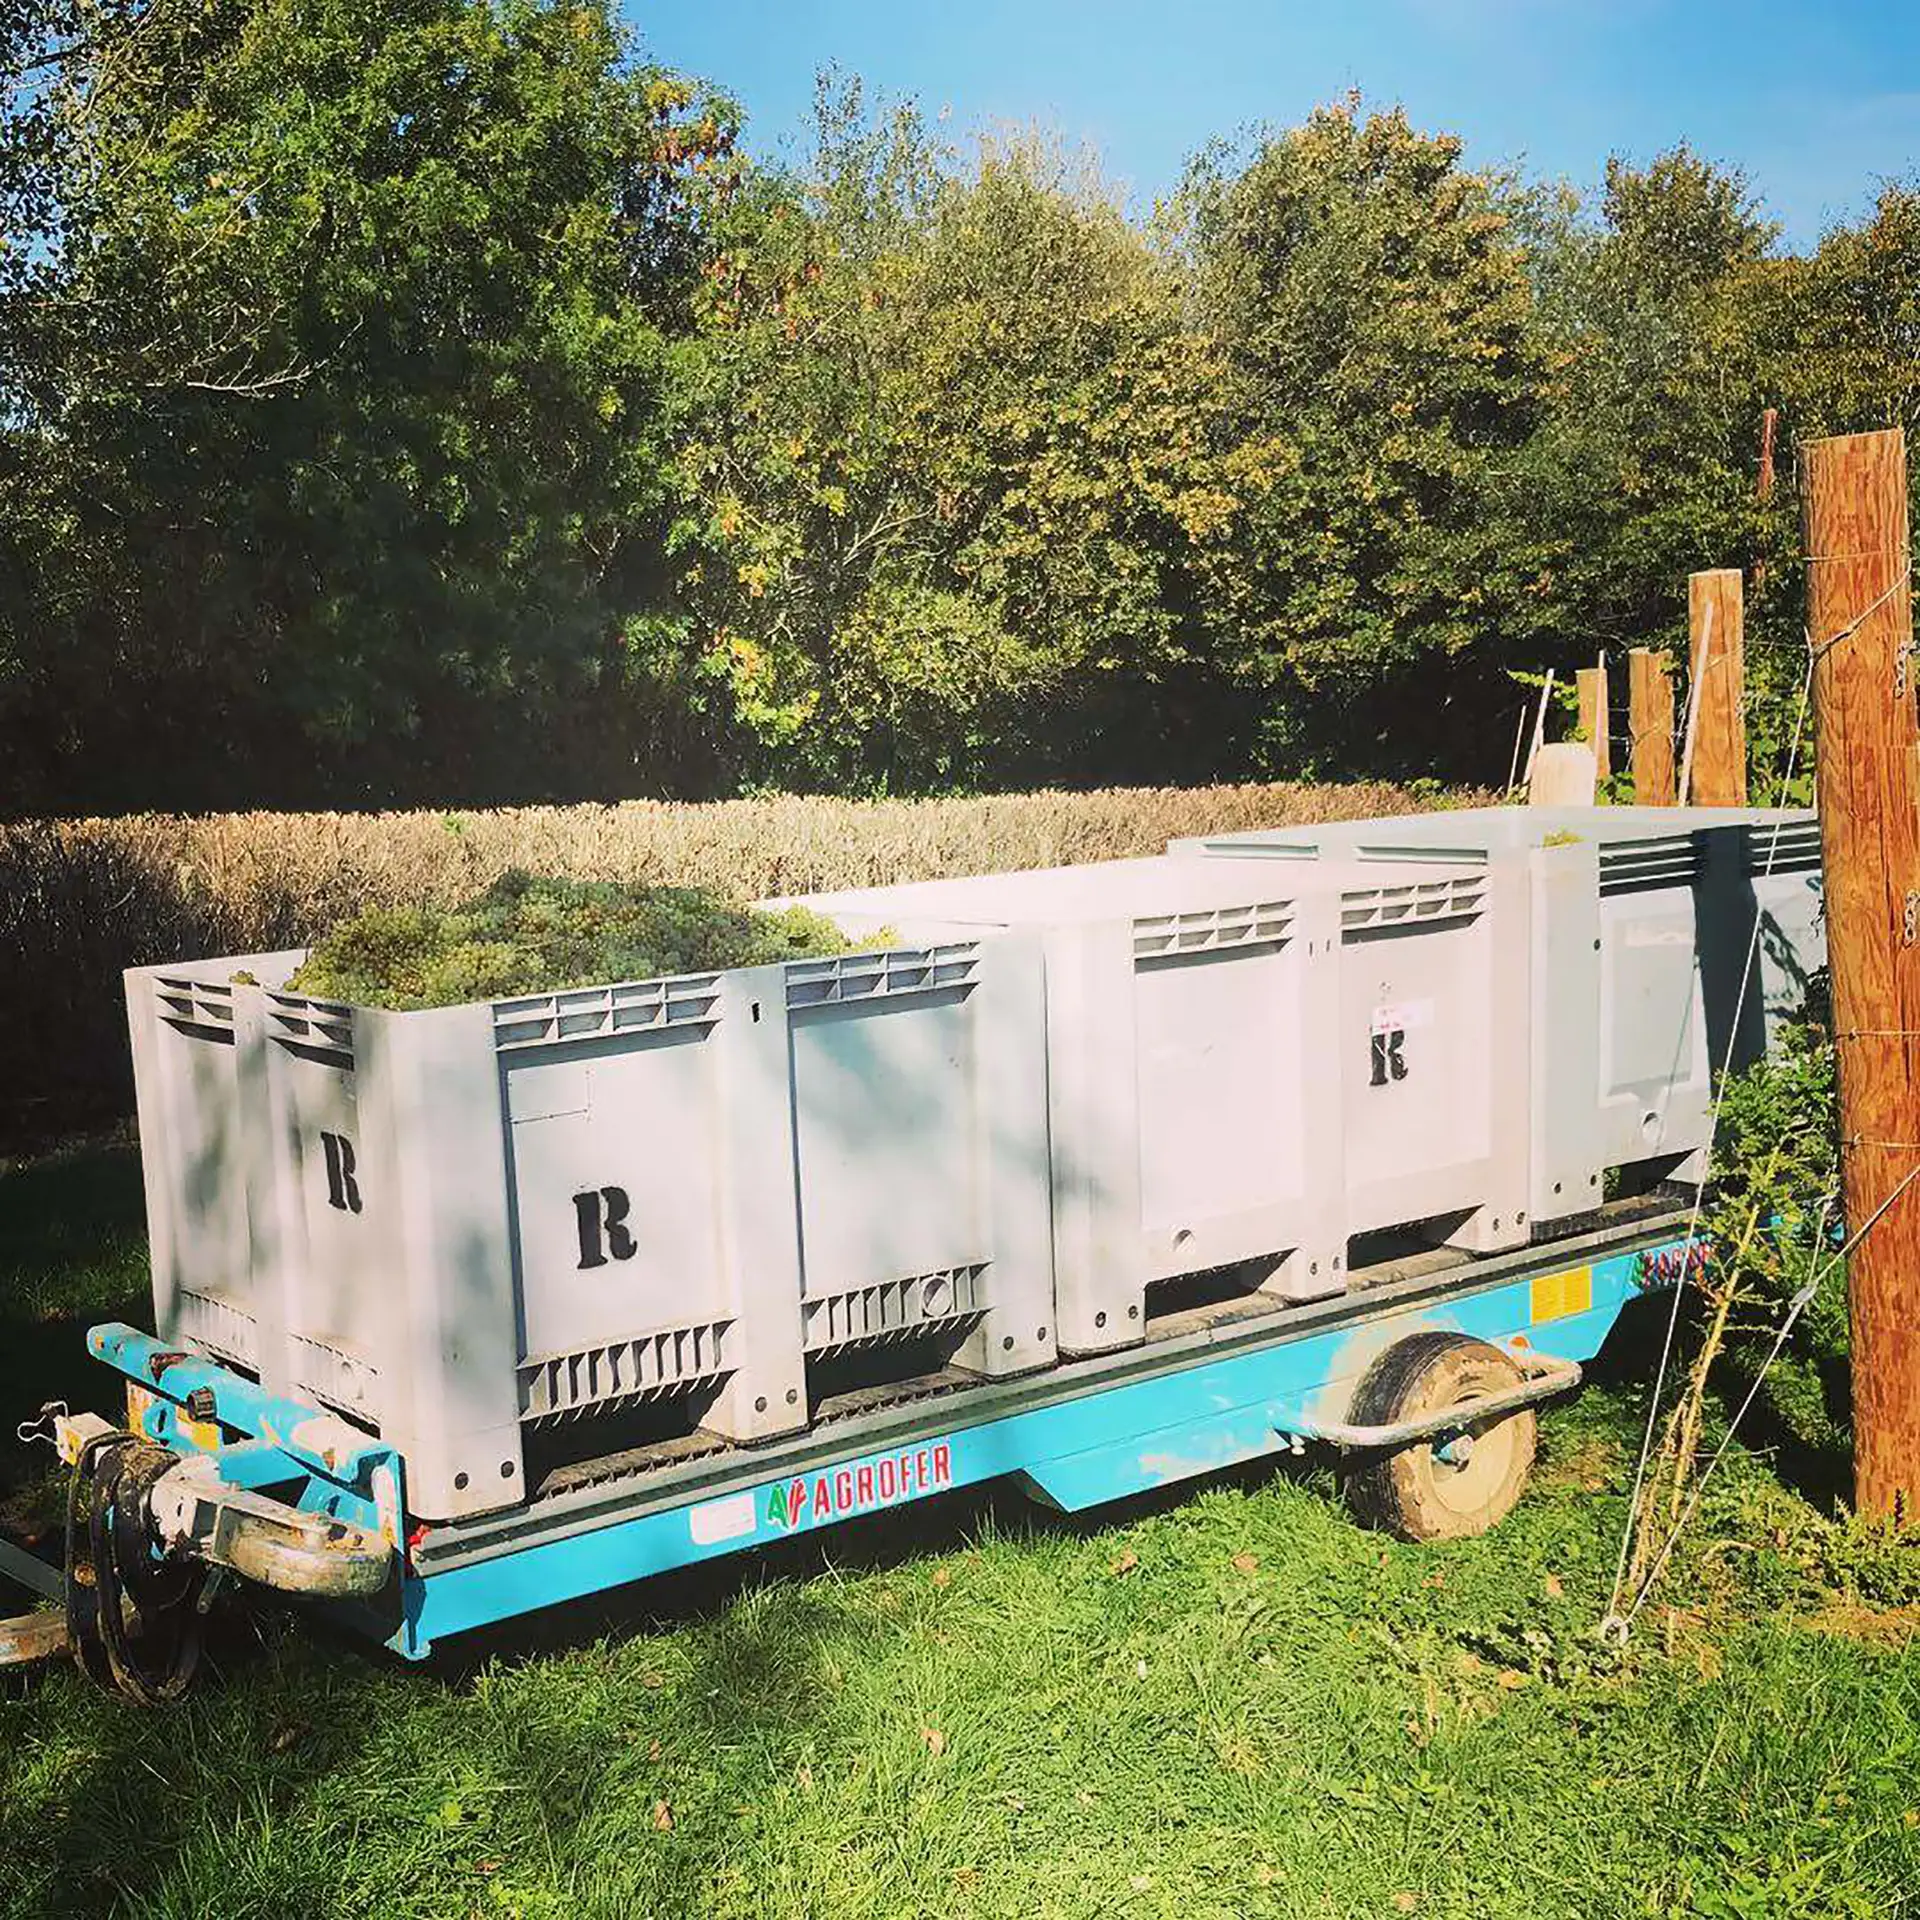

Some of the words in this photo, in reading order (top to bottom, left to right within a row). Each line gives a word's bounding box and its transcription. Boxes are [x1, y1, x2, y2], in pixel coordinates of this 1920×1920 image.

[321, 1131, 362, 1214] R
[572, 1187, 638, 1269] R
[814, 1446, 950, 1517] AGROFER
